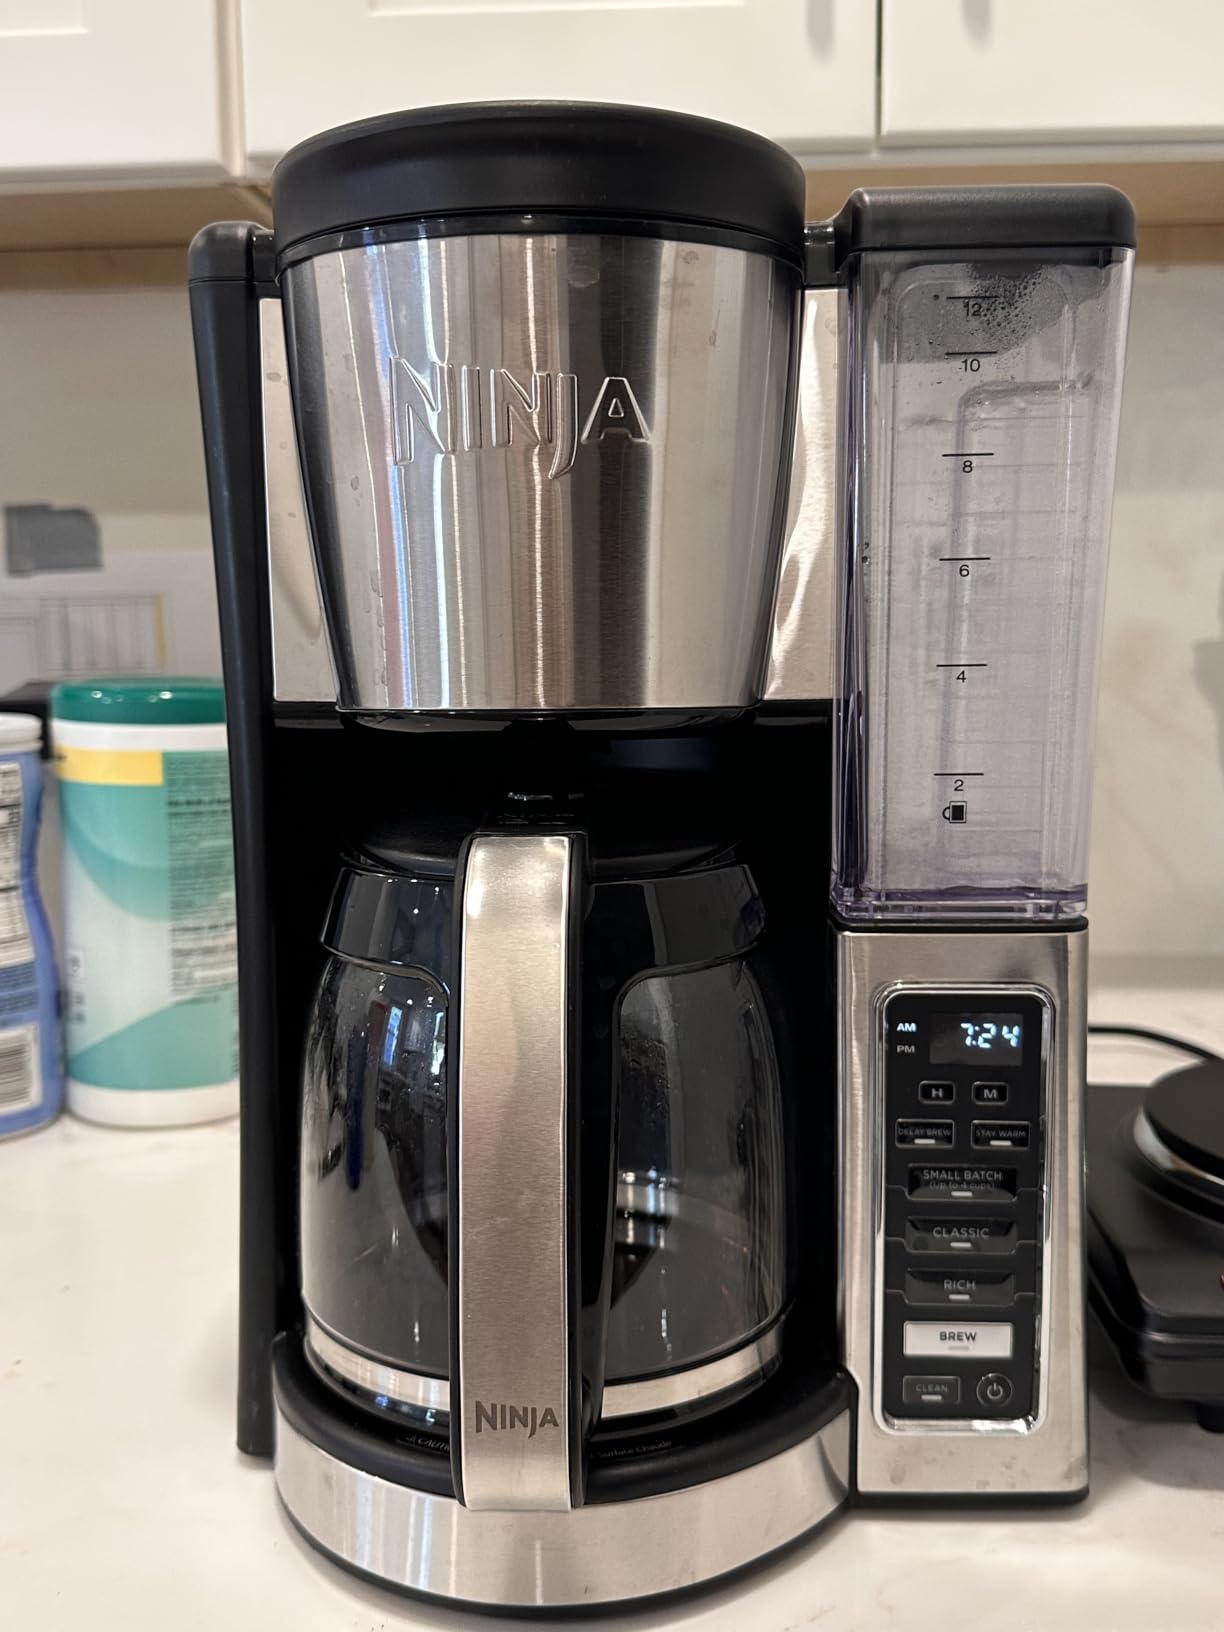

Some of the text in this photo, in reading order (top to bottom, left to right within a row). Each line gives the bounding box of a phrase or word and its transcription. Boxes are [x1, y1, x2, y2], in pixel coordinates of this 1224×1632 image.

[963, 302, 983, 317] 12
[961, 358, 981, 373] 10
[389, 356, 651, 480] NINJA
[962, 460, 973, 474] 8
[958, 564, 970, 578] 6
[956, 670, 967, 683] 4
[953, 779, 964, 792] 2
[896, 1022, 917, 1033] AM
[960, 1022, 1020, 1049] 7:24
[896, 1044, 916, 1054] PM
[931, 1087, 943, 1098] H
[983, 1088, 998, 1099] M
[898, 1128, 951, 1137] DELAY BREW
[976, 1130, 1026, 1138] STAY WARM
[922, 1169, 1003, 1181] SMALL BATCH
[932, 1226, 990, 1238] CLASSIC
[943, 1279, 976, 1290] RICH
[939, 1331, 977, 1342] BREW
[915, 1383, 948, 1393] CLEAN
[475, 1400, 560, 1440] NINJA
